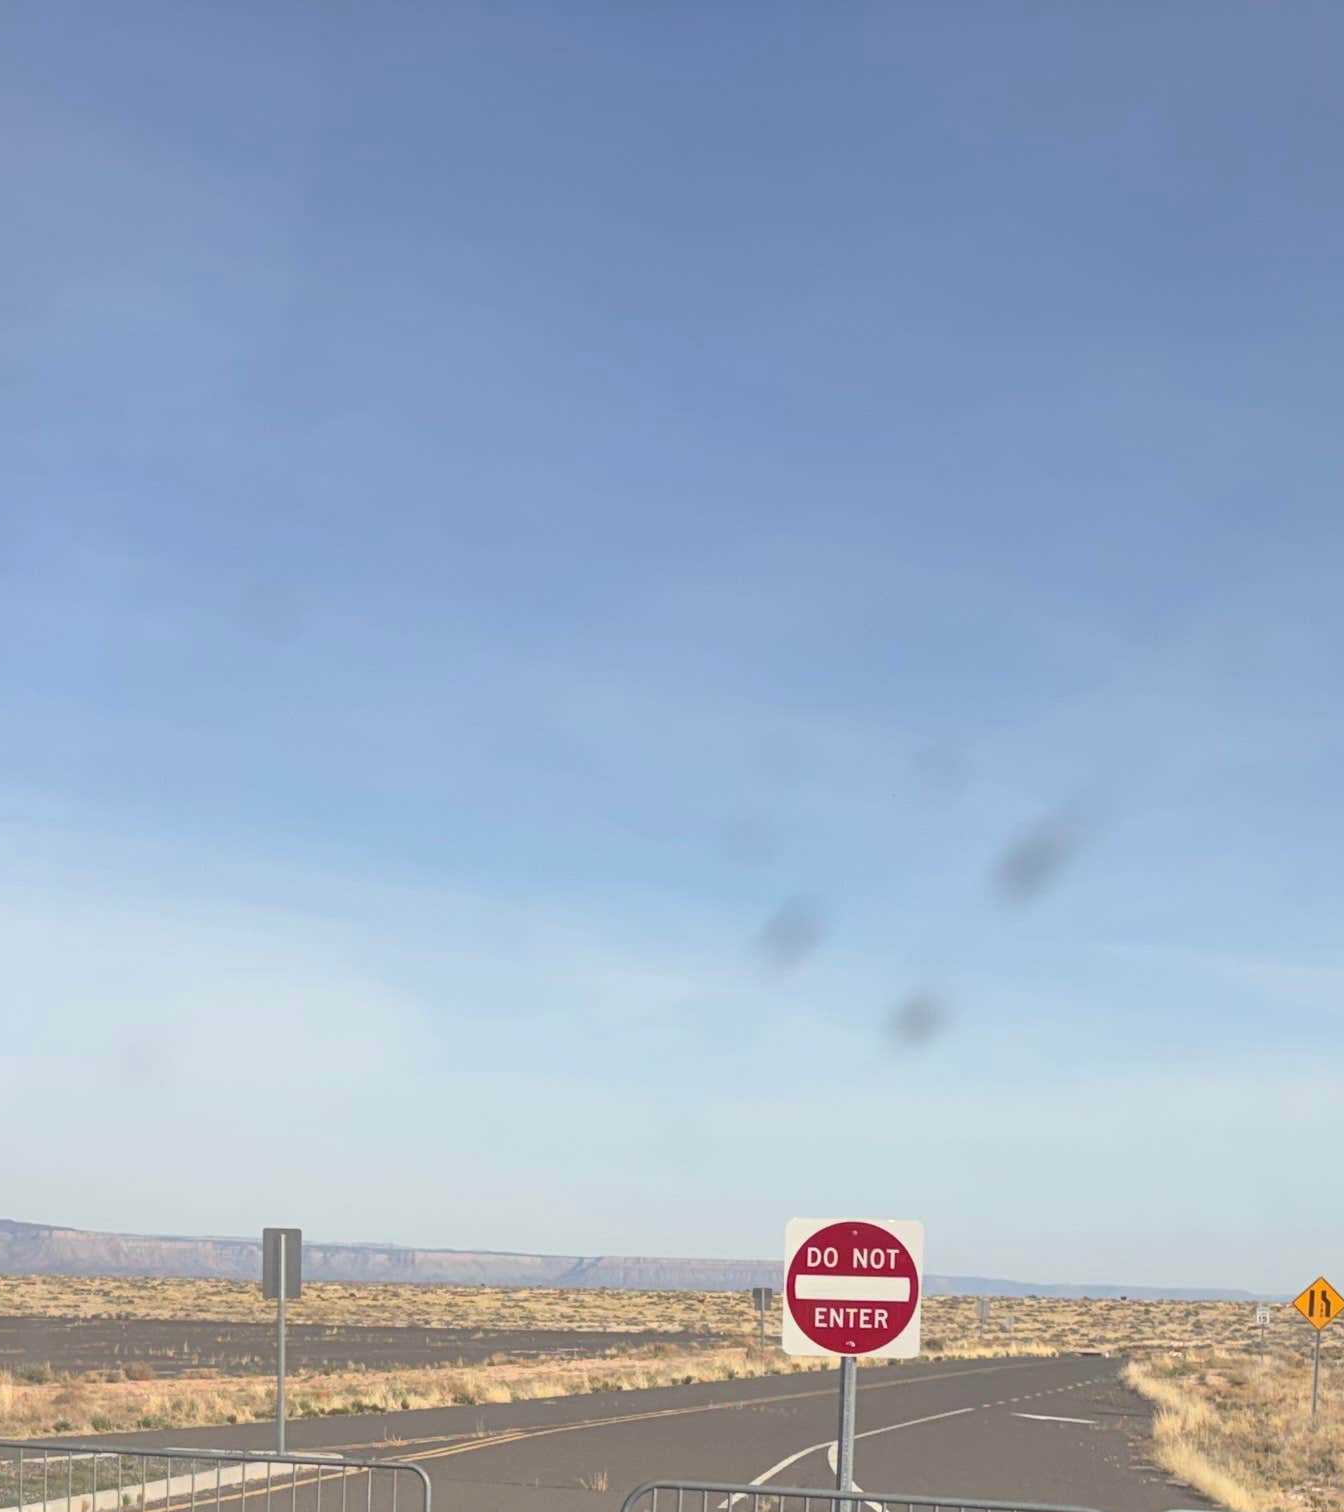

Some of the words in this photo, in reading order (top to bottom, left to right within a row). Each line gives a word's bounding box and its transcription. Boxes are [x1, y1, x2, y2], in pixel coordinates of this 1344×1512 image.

[807, 1247, 838, 1268] DO
[852, 1248, 899, 1270] NOT
[814, 1307, 888, 1329] ENTER
